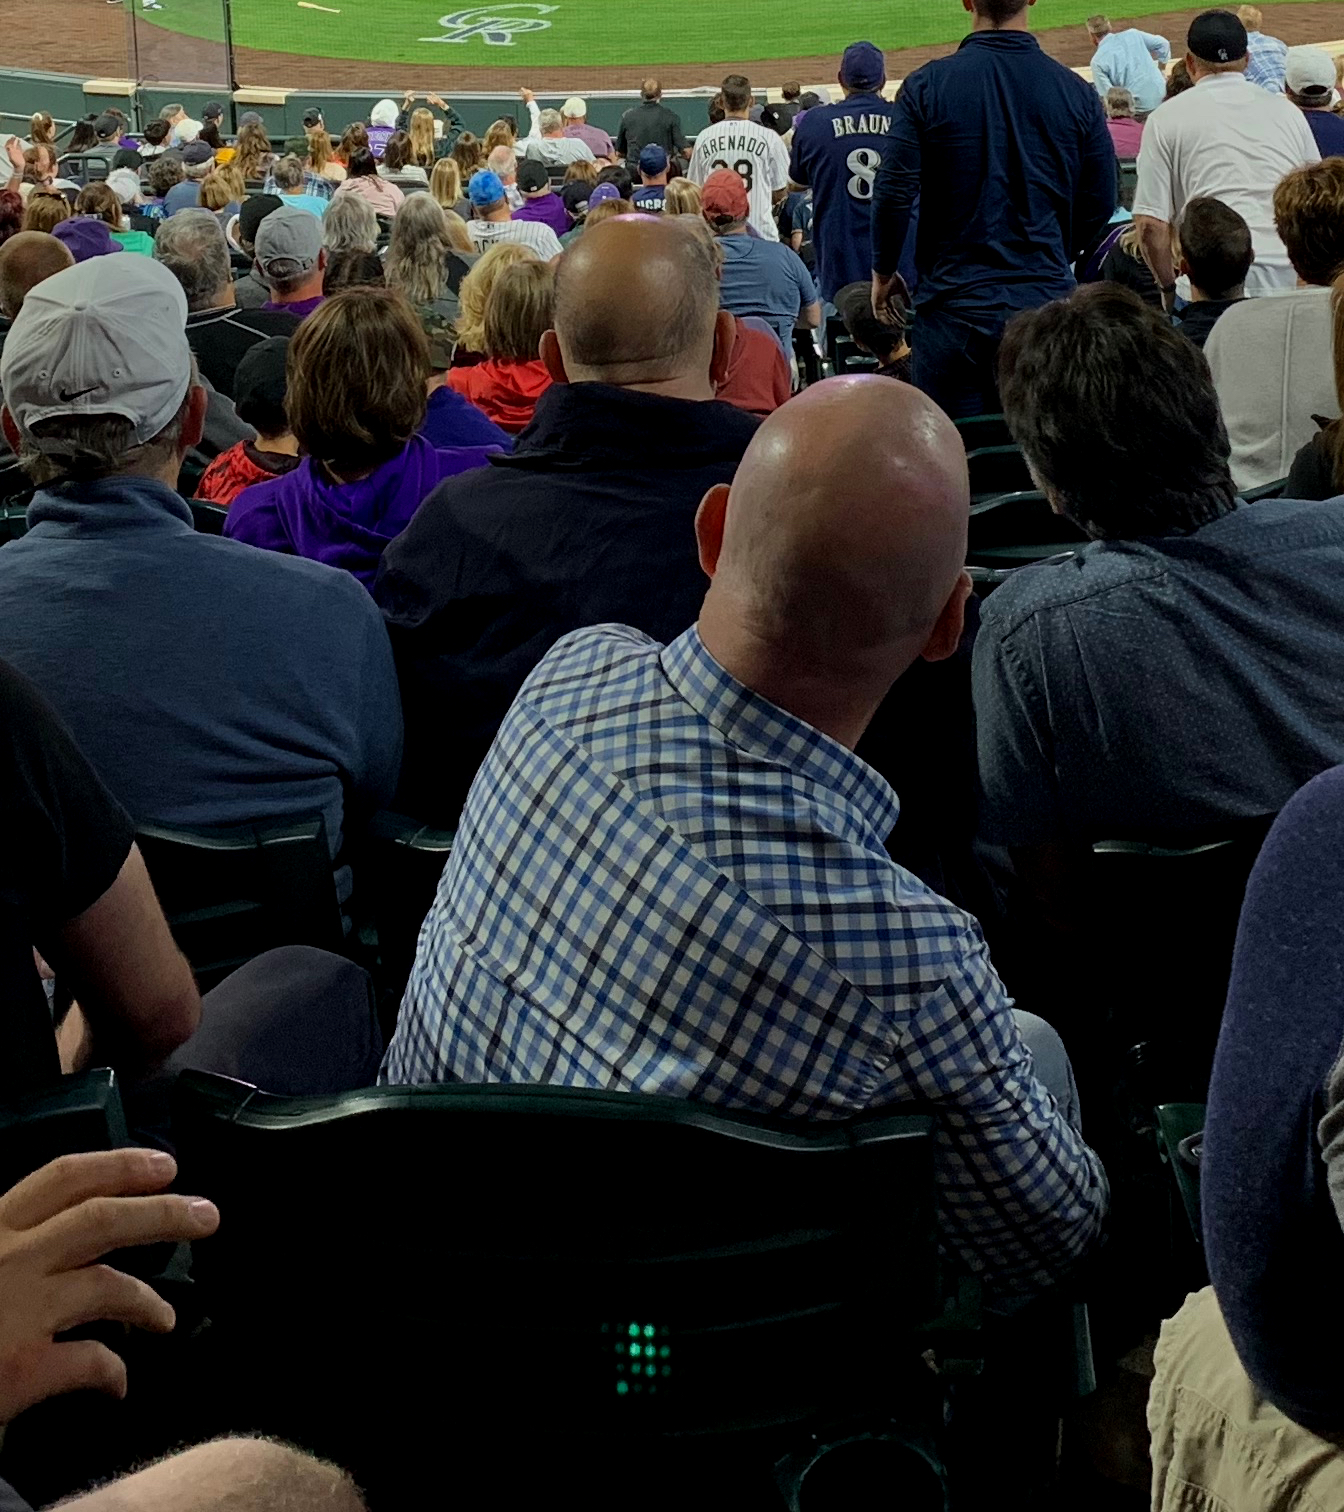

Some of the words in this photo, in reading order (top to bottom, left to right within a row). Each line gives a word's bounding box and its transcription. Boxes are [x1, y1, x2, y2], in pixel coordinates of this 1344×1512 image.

[832, 114, 893, 138] BRAUN
[702, 135, 766, 159] ARENADO
[846, 148, 882, 200] 8
